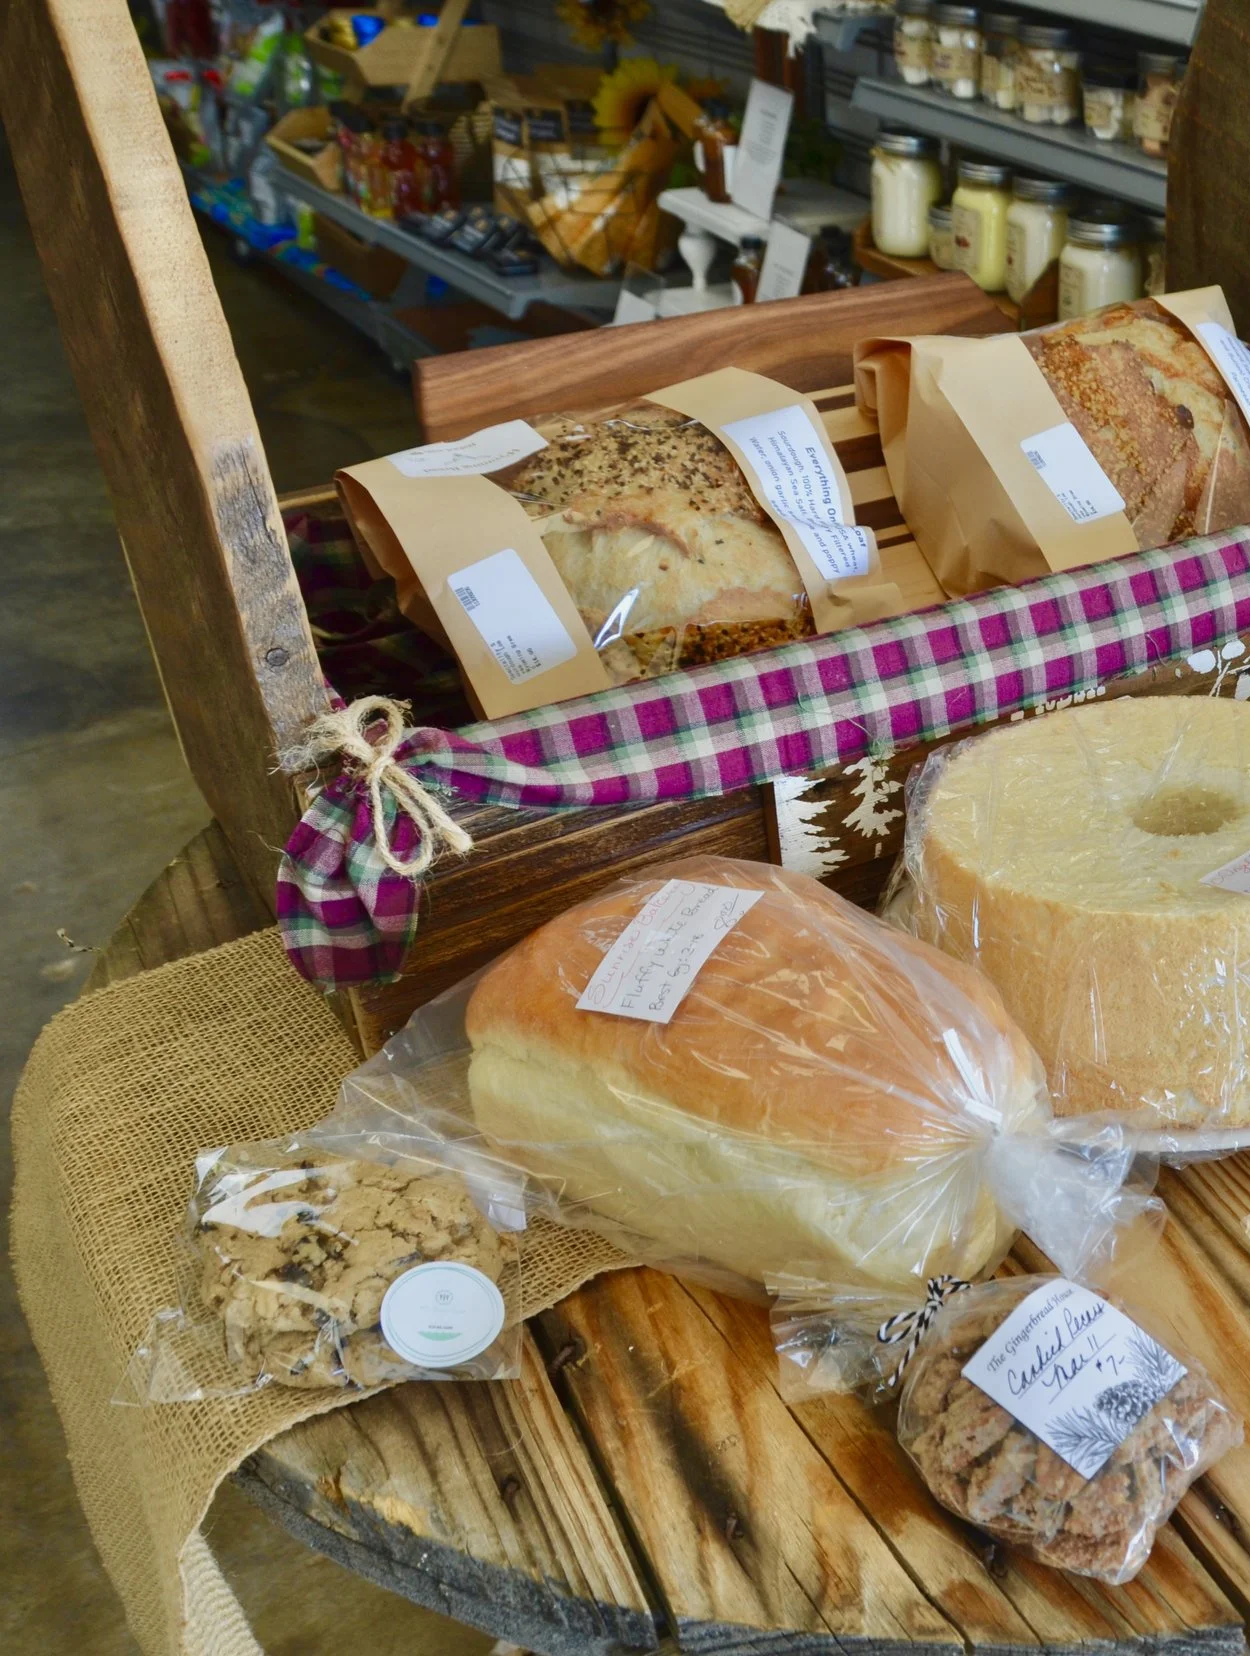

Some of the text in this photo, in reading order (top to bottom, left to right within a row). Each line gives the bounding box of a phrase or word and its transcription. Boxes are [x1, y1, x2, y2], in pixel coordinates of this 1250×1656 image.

[749, 437, 766, 458] Water,
[765, 460, 779, 481] onion
[775, 485, 789, 508] garlic
[814, 533, 826, 547] and
[822, 550, 840, 574] poppy
[768, 437, 793, 476] Himalayan
[831, 535, 852, 568] Filtered
[778, 431, 804, 472] Sourdough,
[802, 475, 812, 496] 100%
[808, 500, 820, 519] Hard
[805, 447, 831, 504] Everything
[588, 929, 641, 1005] Sunrise
[620, 961, 664, 1008] Fluffy
[681, 885, 719, 916] Bread
[649, 983, 671, 1011] Best
[987, 1288, 1075, 1373] The Gingerbread House
[1007, 1326, 1066, 1395] Candied
